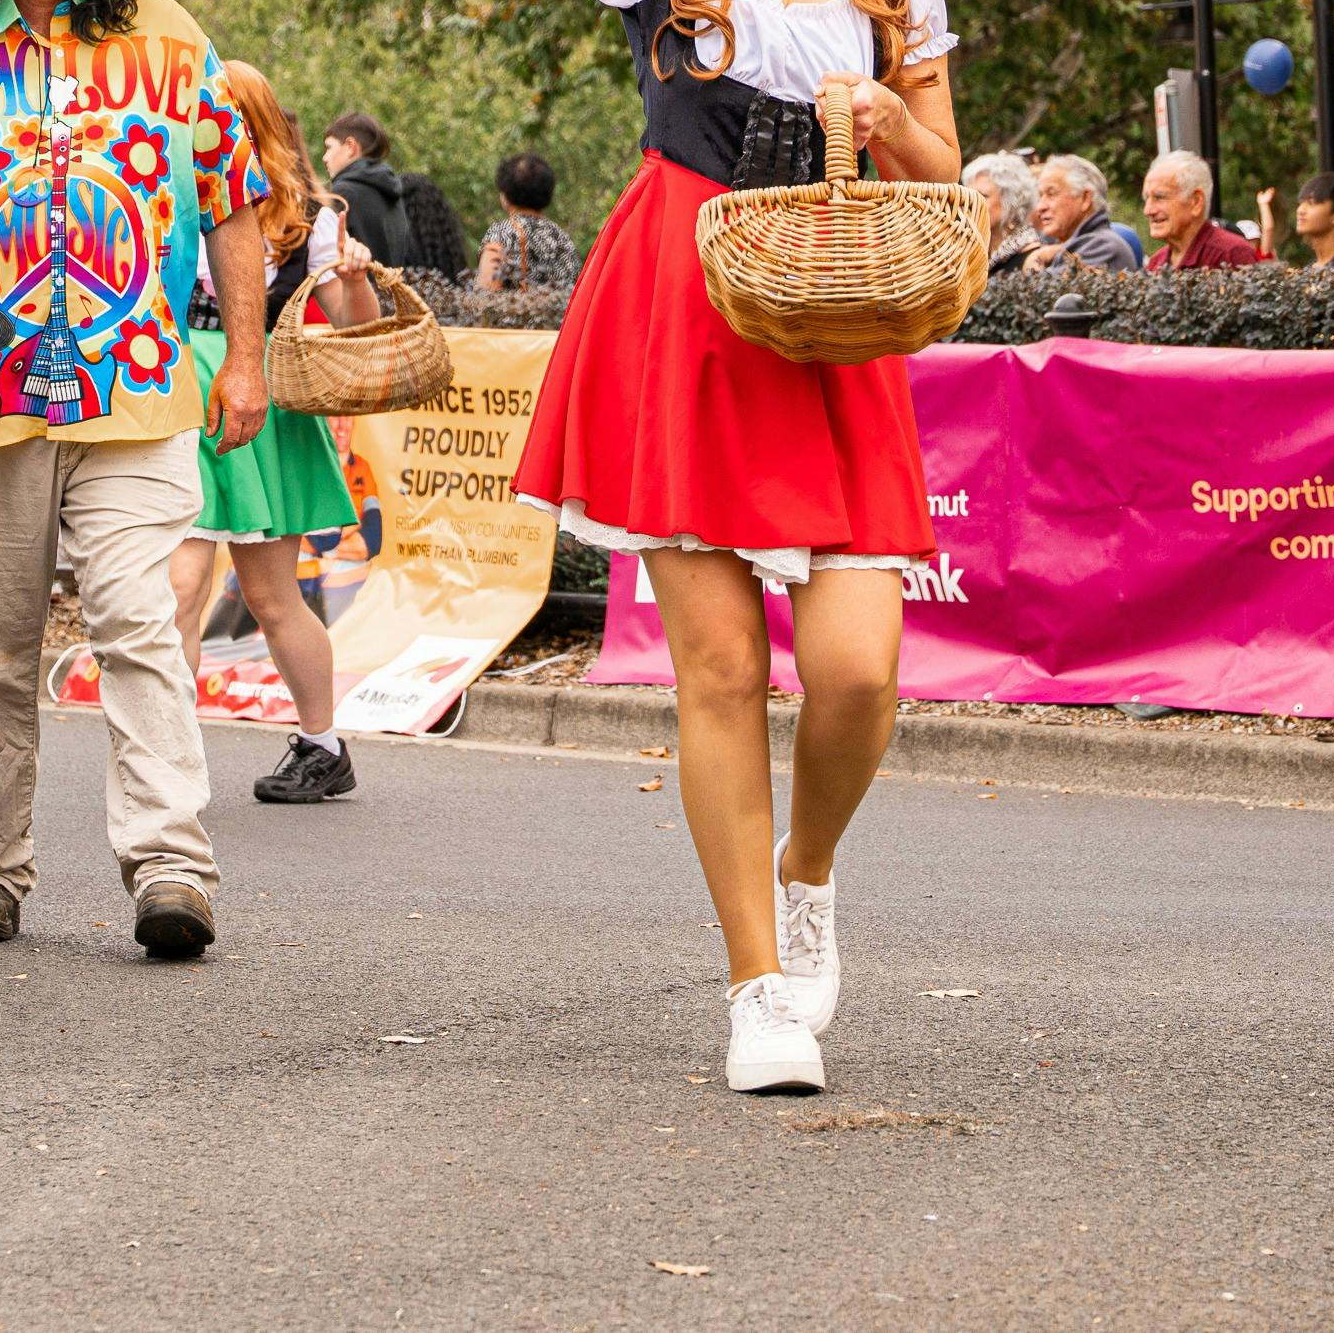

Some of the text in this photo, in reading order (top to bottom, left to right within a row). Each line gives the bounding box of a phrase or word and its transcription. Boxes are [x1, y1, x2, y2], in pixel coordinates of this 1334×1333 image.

[61, 35, 198, 125] LOVE
[481, 388, 533, 417] 1952
[402, 426, 510, 459] PROUDLY
[433, 546, 462, 561] THAN
[466, 547, 519, 566] PLUMBING
[902, 553, 969, 603] ank
